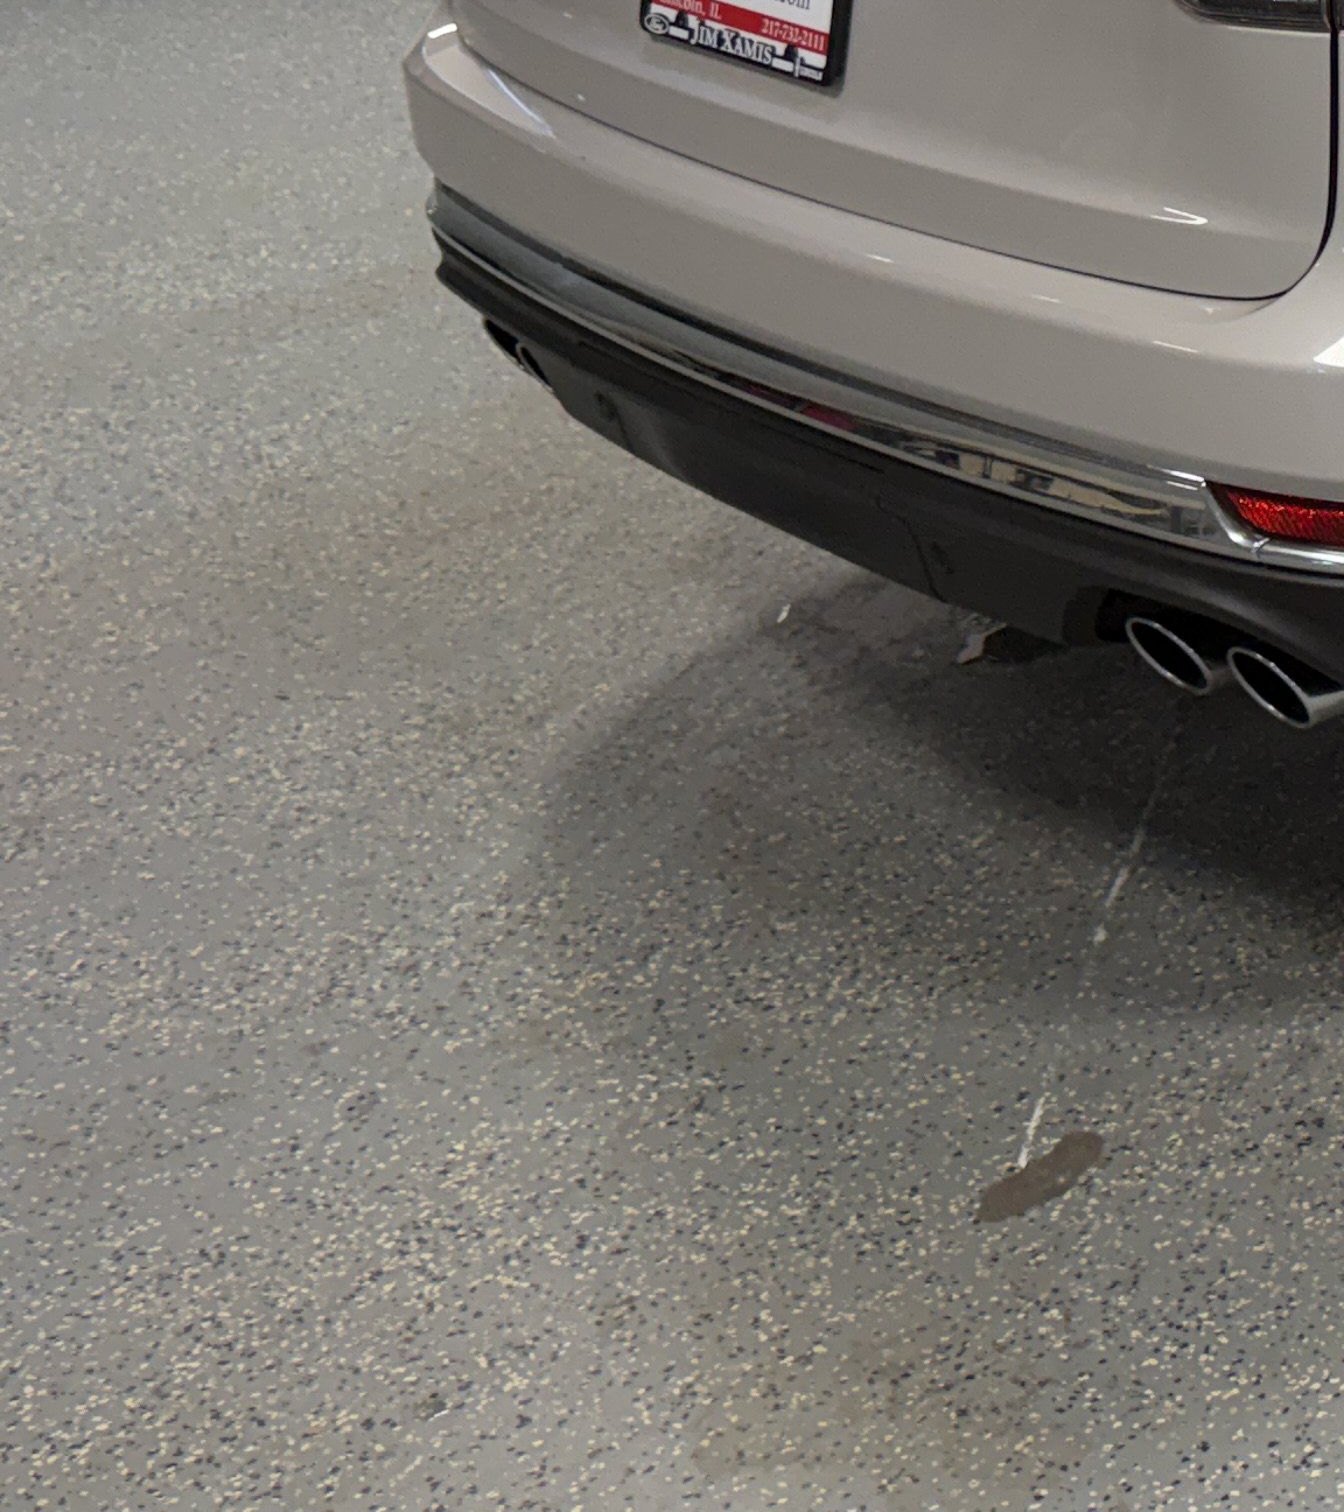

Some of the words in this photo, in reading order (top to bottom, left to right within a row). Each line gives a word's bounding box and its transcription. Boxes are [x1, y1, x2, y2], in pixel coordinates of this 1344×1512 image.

[709, 3, 722, 20] IL
[690, 19, 718, 49] JIM
[721, 29, 773, 65] XAMIS
